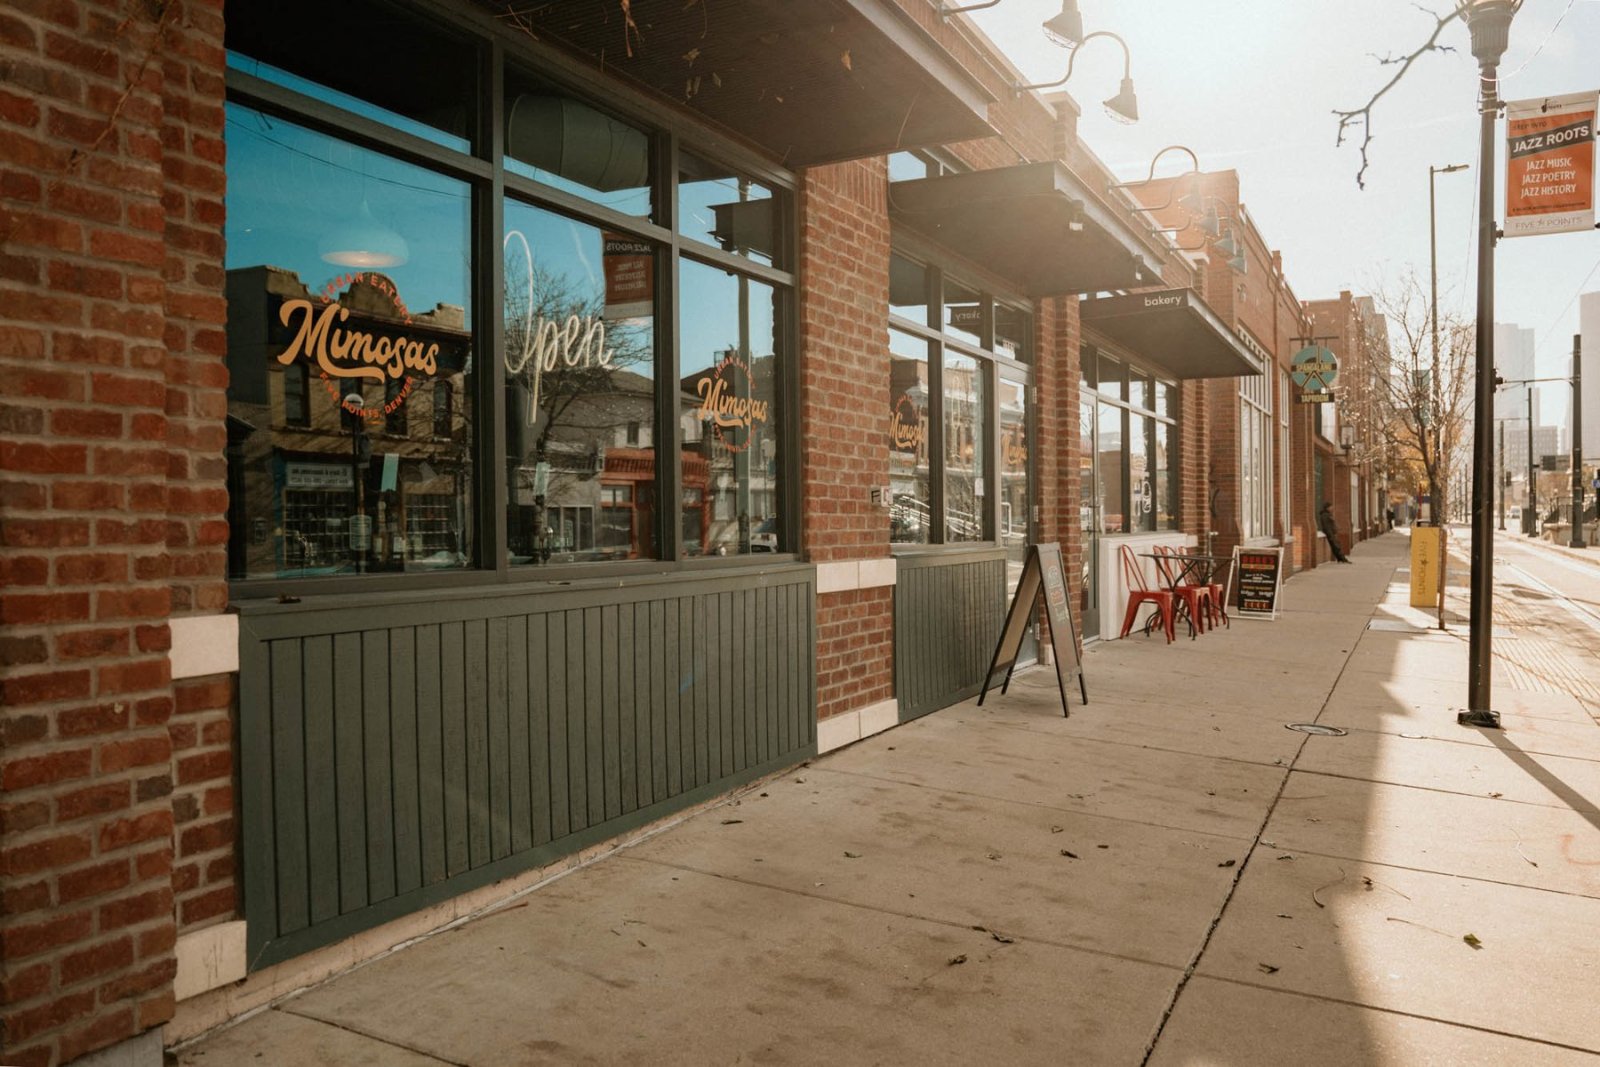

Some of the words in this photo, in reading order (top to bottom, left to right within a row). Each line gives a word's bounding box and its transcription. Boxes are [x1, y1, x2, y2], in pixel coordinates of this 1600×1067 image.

[1513, 137, 1543, 153] JAZZ
[1546, 126, 1589, 146] ROOTS
[1522, 173, 1541, 185] JAZZ
[1543, 170, 1576, 183] POETRY
[1527, 159, 1545, 172] JAZZ
[1547, 157, 1572, 168] MUSIC
[1520, 187, 1540, 199] JAZZ
[1541, 184, 1577, 196] HISTORY
[320, 272, 364, 304] URBAN
[369, 275, 414, 325] EATERY
[1144, 295, 1182, 307] bakery
[277, 299, 439, 384] Mimosas
[384, 375, 414, 415] DENVER
[697, 377, 768, 429] Mimosas
